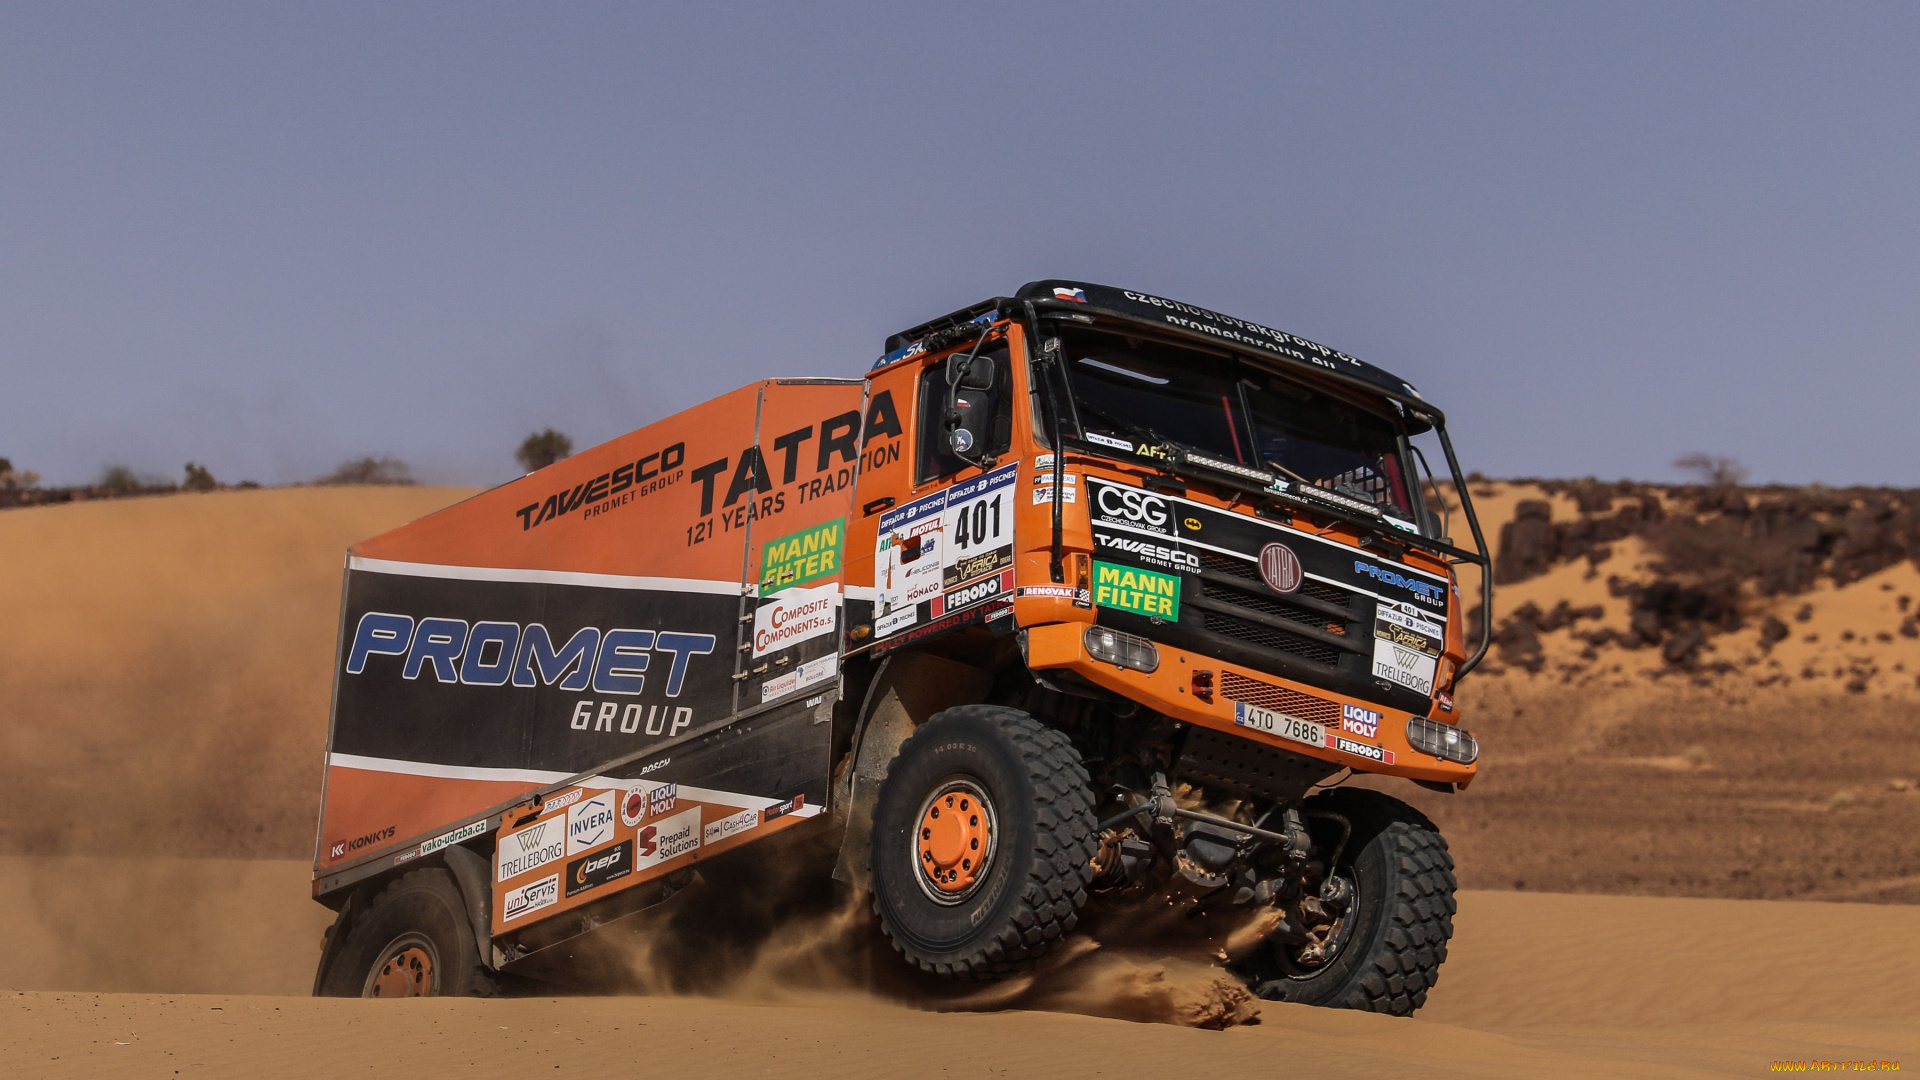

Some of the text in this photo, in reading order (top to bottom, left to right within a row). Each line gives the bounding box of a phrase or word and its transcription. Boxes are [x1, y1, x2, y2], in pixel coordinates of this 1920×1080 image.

[1123, 291, 1361, 366] czechoslovakgroup.cz
[690, 389, 903, 517] TATRA
[516, 441, 685, 531] TAWESCO
[583, 470, 683, 520] PROMET GROUP
[686, 440, 900, 547] 121 YEARS TRADITION
[949, 486, 975, 501] DIFFAZUR
[989, 470, 1016, 486] PISCINES
[881, 511, 905, 529] DIFFAZUR
[919, 496, 944, 513] PISCINES
[955, 493, 1002, 550] 401
[1098, 486, 1167, 526] CSG
[911, 518, 941, 537] MOTUL
[1101, 515, 1167, 534] CZECHOSLOVAK GROUP
[767, 525, 838, 568] MANN
[1095, 533, 1199, 567] TAWESCO
[764, 550, 835, 592] FILTER
[965, 554, 998, 573] AFRICA
[1140, 555, 1202, 575] PROMET GROUP
[1265, 546, 1294, 589] TATRA
[907, 582, 939, 601] MONACO
[948, 580, 998, 609] FERODO
[1025, 587, 1072, 596] RENOVAK
[1100, 566, 1174, 597] MANN
[1354, 560, 1444, 599] PROMET
[771, 598, 829, 629] COMPOSITE
[1097, 585, 1173, 616] FILTER
[1403, 605, 1415, 615] 401
[1414, 592, 1444, 607] GROUP
[909, 616, 960, 638] POWERED
[962, 610, 976, 622] BY
[980, 597, 1010, 614] TATRA
[1378, 608, 1403, 622] DIFFAZUR
[1416, 622, 1439, 636] PISCINES
[755, 616, 819, 652] COMPONENTS
[1396, 633, 1427, 648] AFRICA
[346, 612, 717, 697] PROMET
[1376, 661, 1430, 694] TRELLEBORG
[571, 700, 693, 737] GROUP
[1284, 718, 1318, 742] 7686
[1343, 704, 1377, 725] LIQUI
[1343, 719, 1377, 738] MOLY
[1339, 740, 1381, 759] FERODO
[651, 783, 676, 803] LIQUI
[651, 797, 676, 816] MOLY
[422, 822, 485, 853] vako-udrzba.cz
[570, 809, 613, 836] INVERA
[660, 826, 690, 847] Prepaid
[348, 825, 396, 852] KONKYS
[660, 837, 698, 859] Solutions
[501, 842, 562, 879] TRELLEBORG
[585, 852, 621, 874] bep
[507, 881, 556, 910] uniServis
